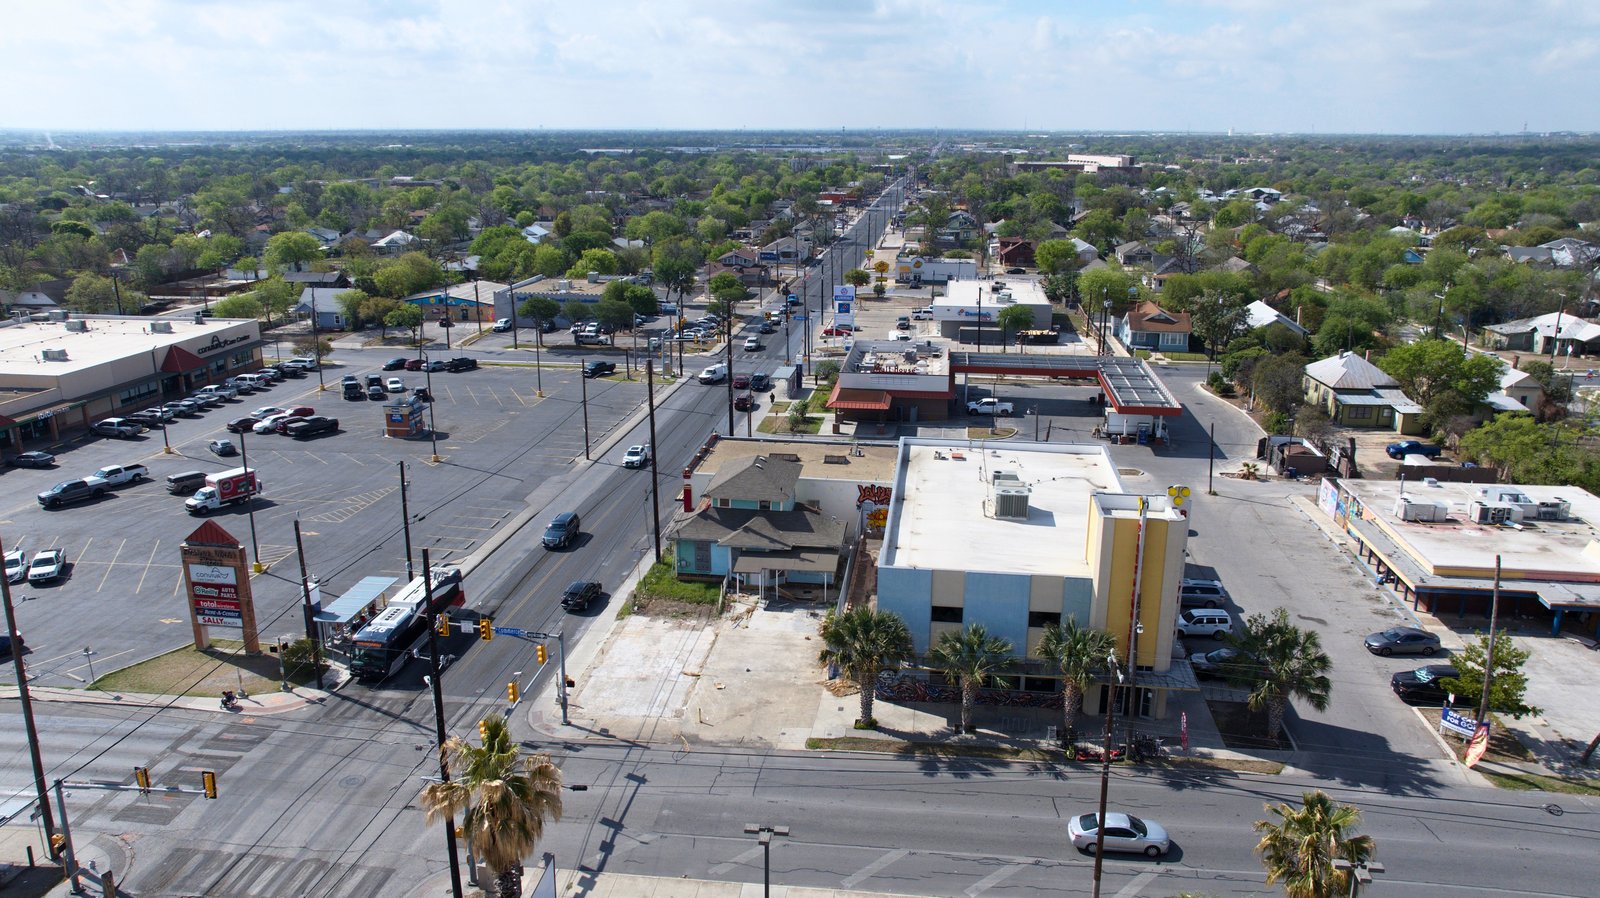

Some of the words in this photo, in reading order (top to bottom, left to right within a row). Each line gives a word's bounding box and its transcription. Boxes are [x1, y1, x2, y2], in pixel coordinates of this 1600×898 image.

[200, 600, 217, 608] total
[202, 616, 223, 625] SALLY
[1447, 716, 1459, 725] FOR
[1461, 721, 1476, 730] GOL
